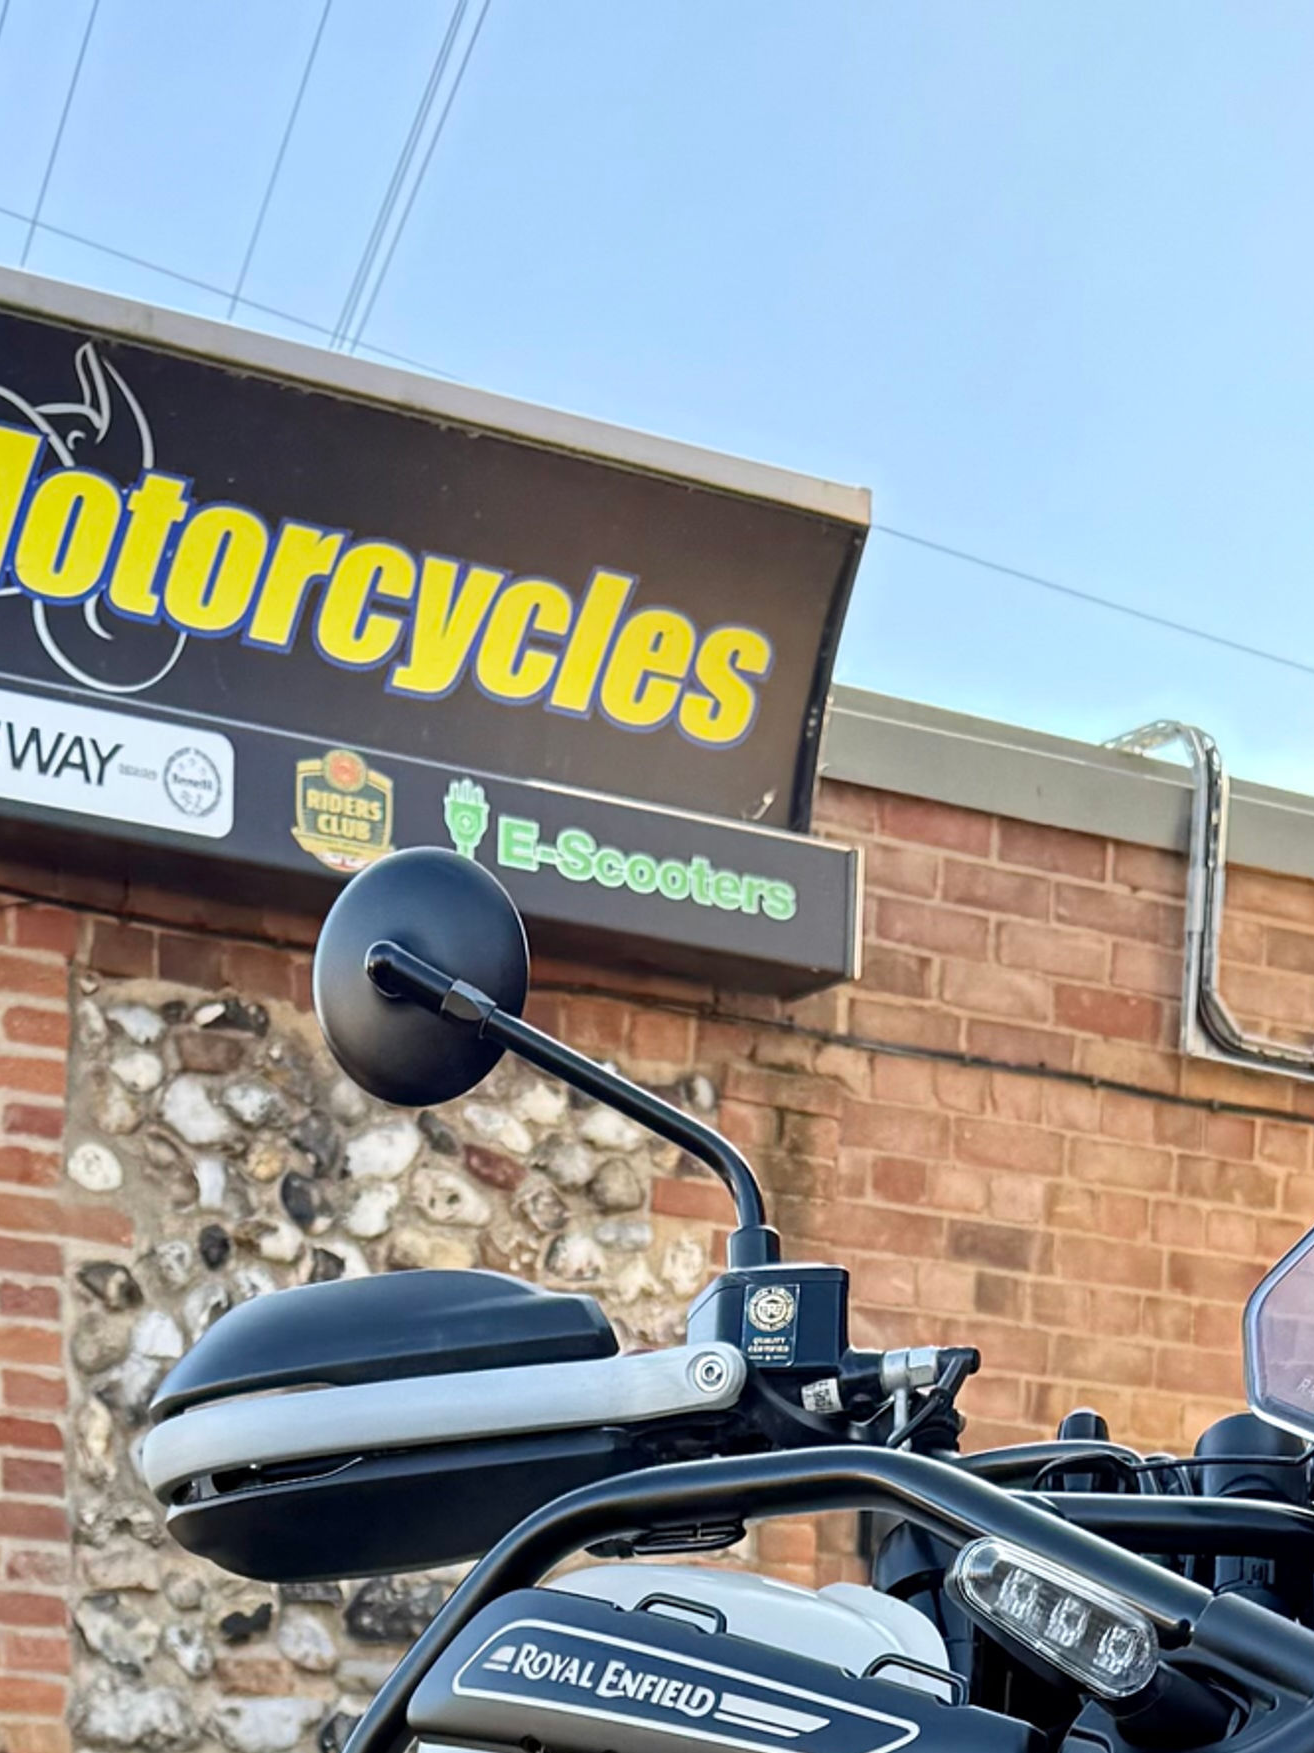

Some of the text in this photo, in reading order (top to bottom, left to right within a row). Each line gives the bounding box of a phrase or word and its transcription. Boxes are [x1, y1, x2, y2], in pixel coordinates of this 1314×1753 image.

[305, 788, 383, 823] RIDERS
[316, 813, 373, 842] CLUB
[496, 815, 797, 921] E-Scooters
[511, 1642, 716, 1718] ROYAL ENFIELD
